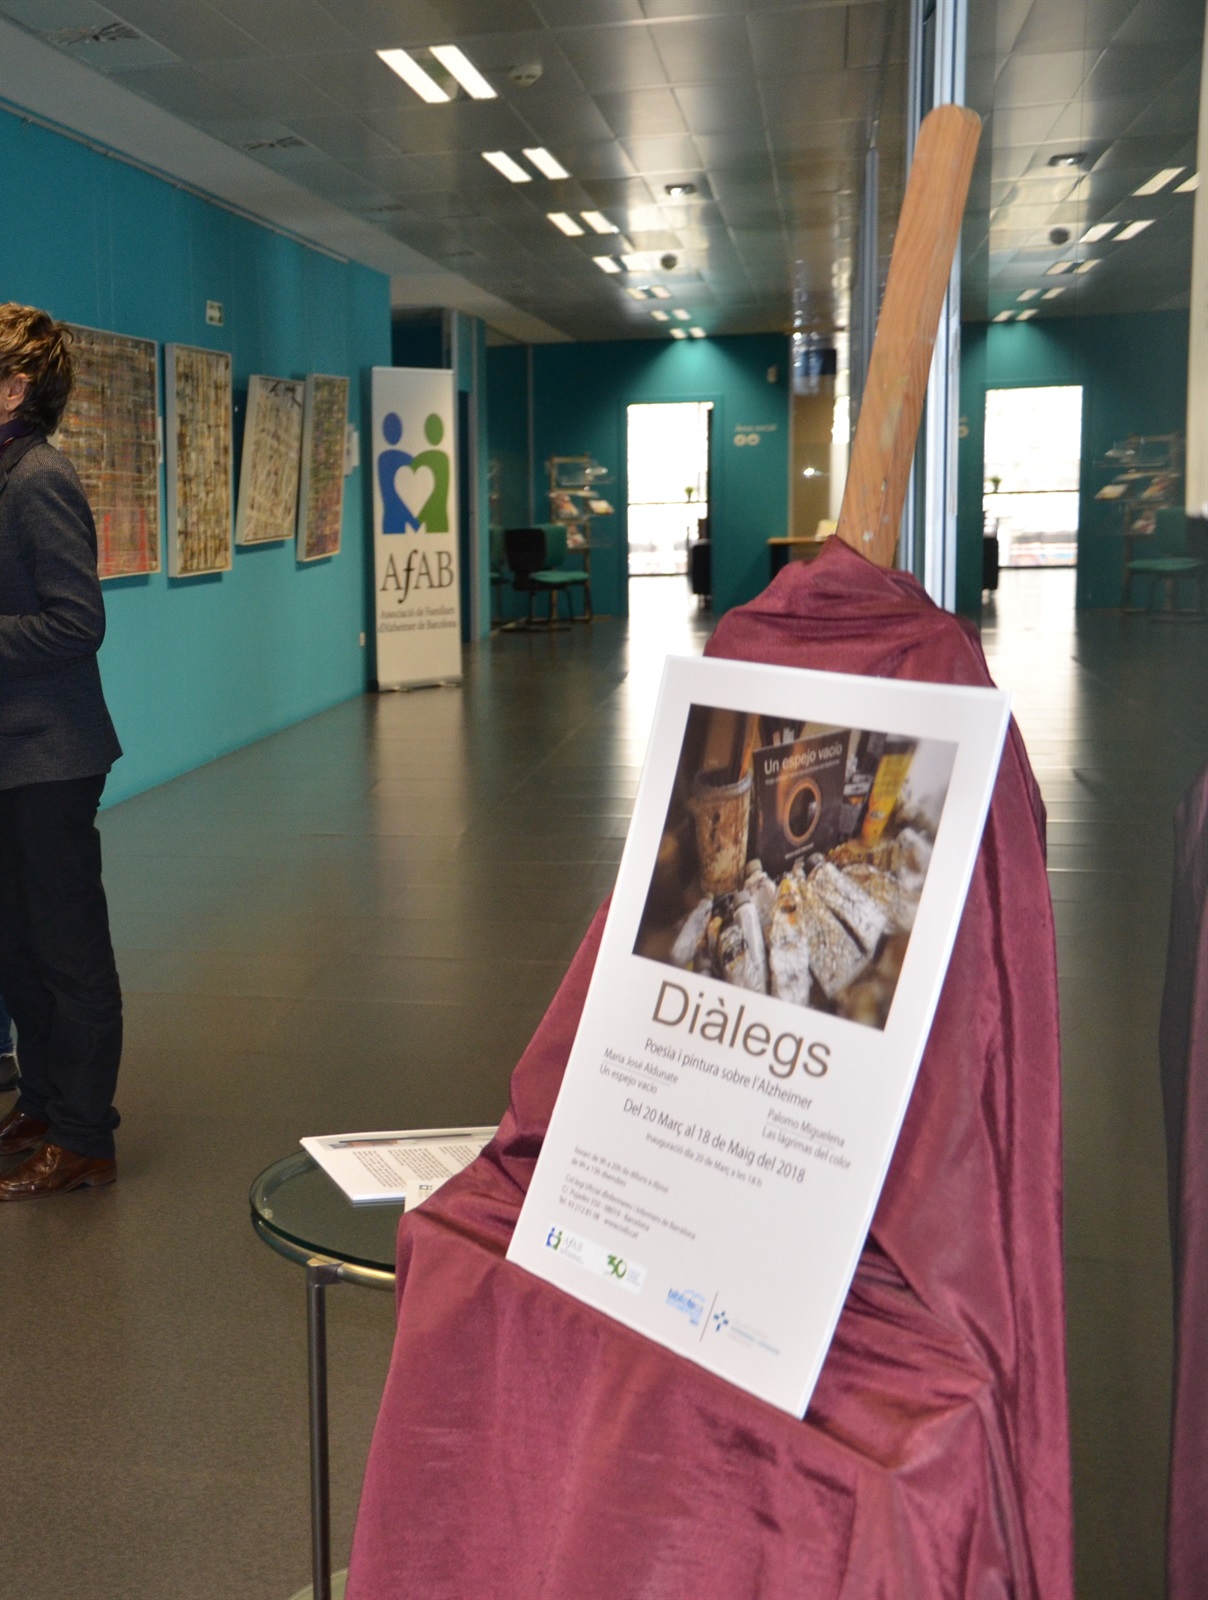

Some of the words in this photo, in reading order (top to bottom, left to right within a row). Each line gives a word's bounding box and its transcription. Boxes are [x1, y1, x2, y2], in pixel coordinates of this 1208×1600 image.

[379, 549, 454, 604] AfAB
[764, 759, 779, 776] Un
[781, 749, 817, 769] espejo
[818, 741, 843, 760] vacío
[652, 979, 831, 1079] Diàlegs
[599, 1064, 610, 1076] Un
[611, 1071, 636, 1086] espejo
[626, 1056, 642, 1070] José
[643, 1062, 678, 1083] Aldunate
[644, 1038, 675, 1060] Poesia
[677, 1049, 682, 1061] i
[681, 1054, 719, 1076] pintura
[721, 1068, 750, 1087] sobre
[752, 1076, 812, 1109] l'Alzheimer
[623, 1098, 642, 1116] Del
[642, 1106, 657, 1122] 20
[657, 1112, 682, 1136] Març
[684, 1124, 696, 1137] al
[698, 1128, 710, 1144] 18
[711, 1134, 726, 1150] de
[727, 1140, 755, 1165] Maig
[757, 1153, 776, 1170] del
[776, 1160, 805, 1183] 2018
[762, 1126, 775, 1140] Las
[814, 1146, 829, 1160] del
[829, 1154, 851, 1169] color
[800, 1121, 844, 1147] Miguelena
[704, 1157, 713, 1166] de
